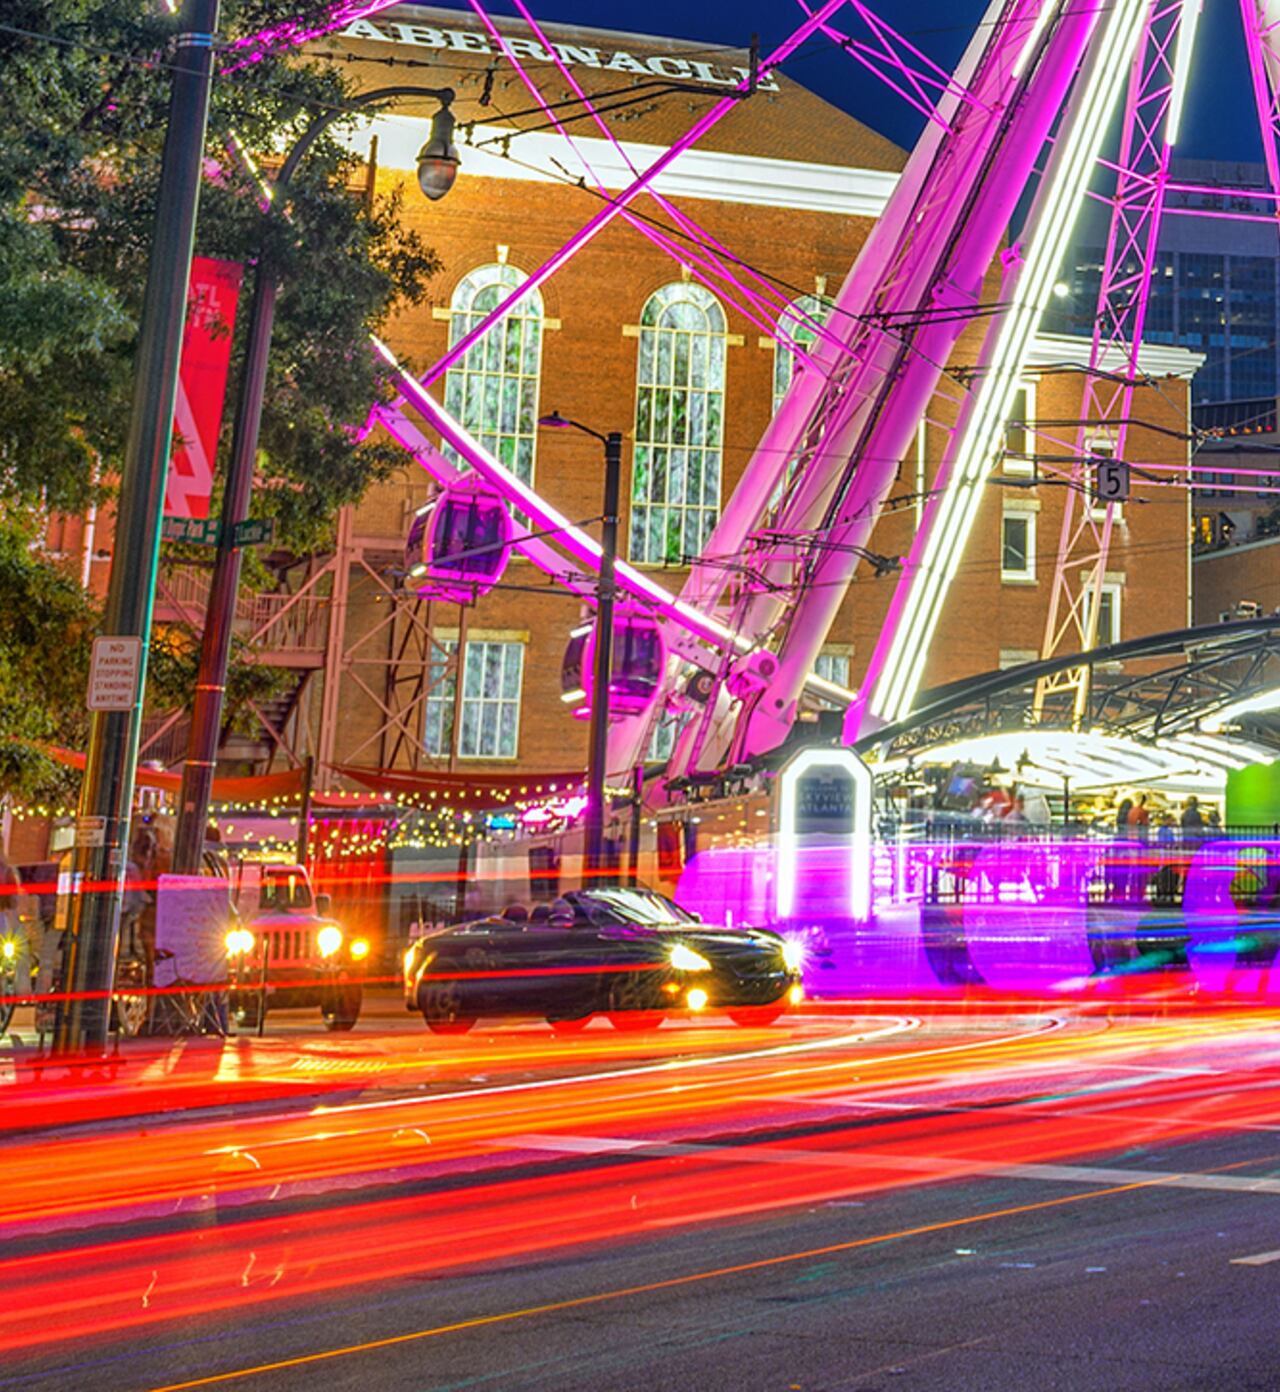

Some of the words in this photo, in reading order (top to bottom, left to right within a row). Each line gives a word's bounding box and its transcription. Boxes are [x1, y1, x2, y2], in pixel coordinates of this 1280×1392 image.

[337, 18, 780, 92] ABERNACLE
[1107, 468, 1120, 496] 5
[110, 643, 125, 653] NO
[99, 655, 134, 666] PARKING
[95, 694, 130, 703] ANYTIME
[799, 804, 851, 813] ATLANTA
